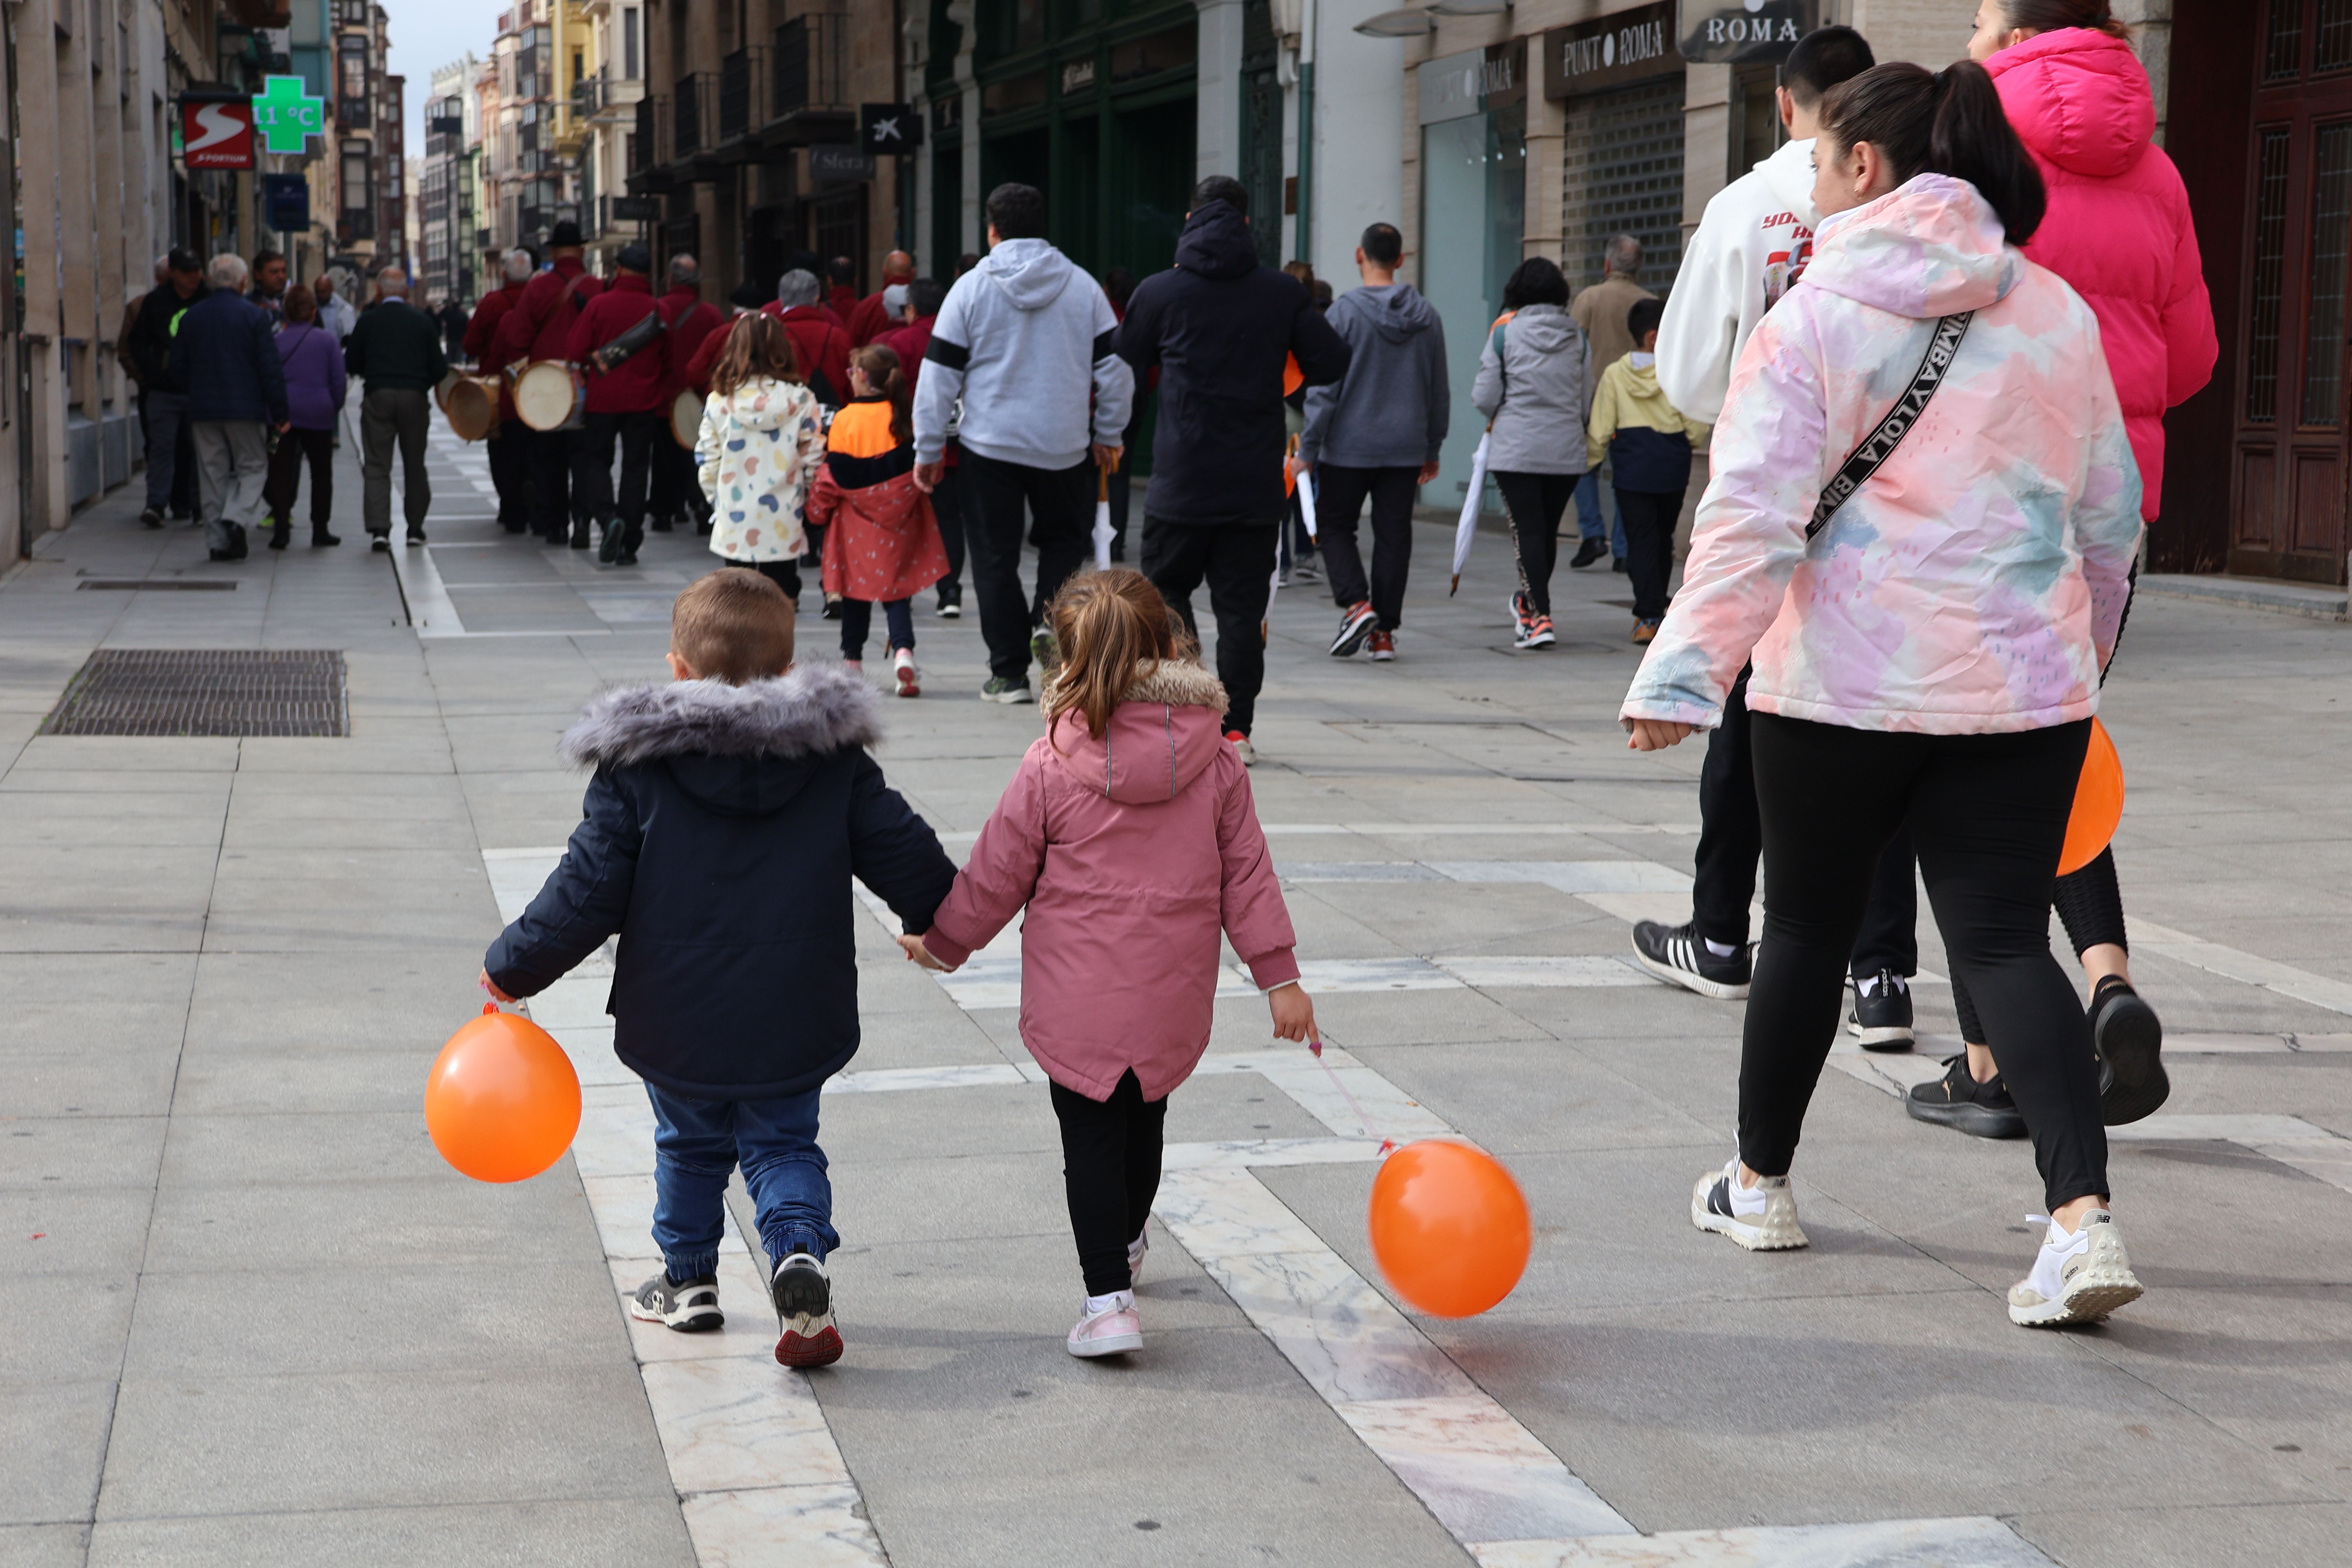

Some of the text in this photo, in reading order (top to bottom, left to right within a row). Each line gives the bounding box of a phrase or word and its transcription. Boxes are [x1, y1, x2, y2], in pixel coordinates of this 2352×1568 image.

[1619, 20, 1663, 65] ROMA
[1706, 18, 1798, 44] ROMA
[252, 105, 314, 126] 11 °C
[192, 154, 248, 163] SPORTIUM
[1857, 404, 1918, 462] LOLA
